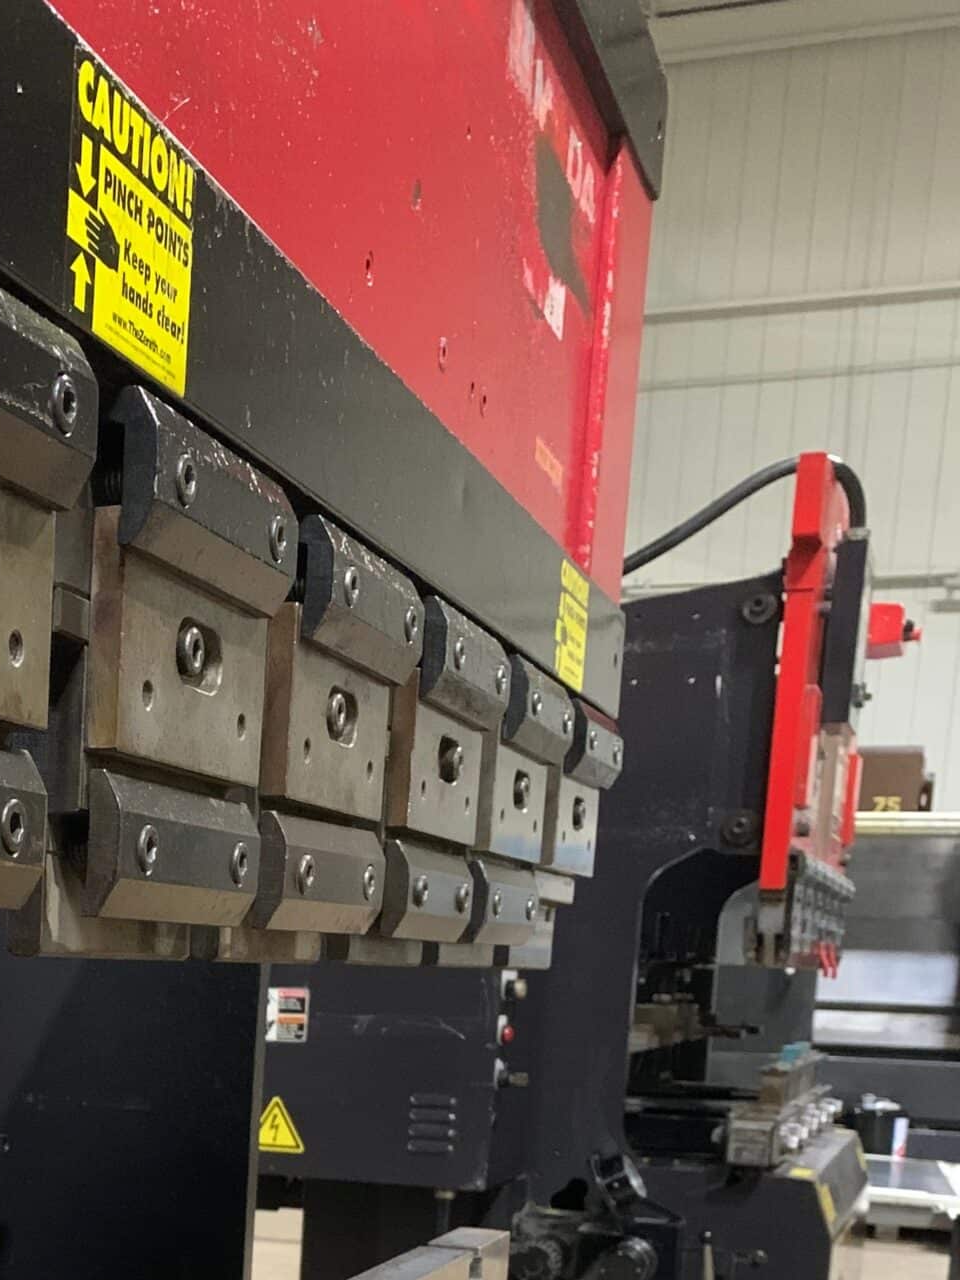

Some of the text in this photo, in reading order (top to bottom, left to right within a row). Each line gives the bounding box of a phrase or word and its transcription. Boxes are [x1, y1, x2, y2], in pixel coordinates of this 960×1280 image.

[78, 60, 194, 220] CAUTION!
[104, 167, 189, 268] PINCH POINTS
[121, 271, 185, 345] hands clear!
[123, 237, 178, 303] Keep your
